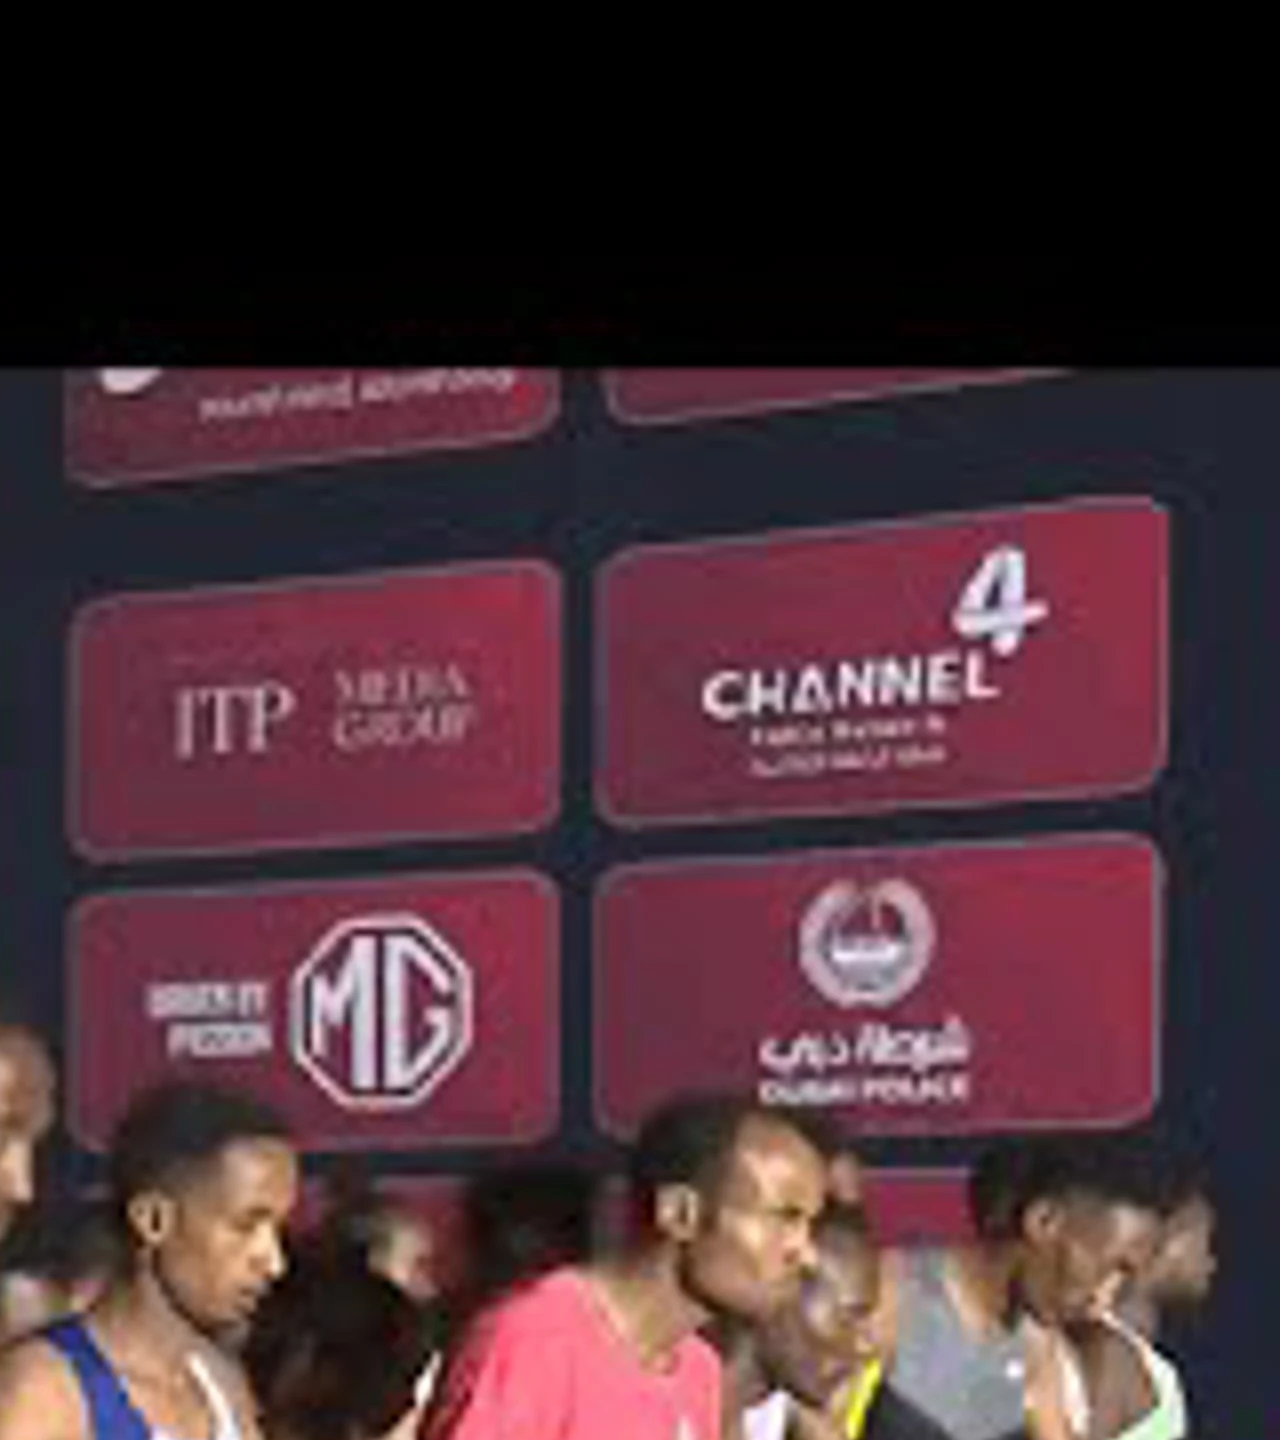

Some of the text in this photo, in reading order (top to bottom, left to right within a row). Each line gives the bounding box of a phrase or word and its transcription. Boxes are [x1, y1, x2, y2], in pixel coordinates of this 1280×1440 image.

[700, 543, 1049, 721] CHANNEL 4
[175, 681, 296, 760] ITP
[312, 933, 453, 1091] MG
